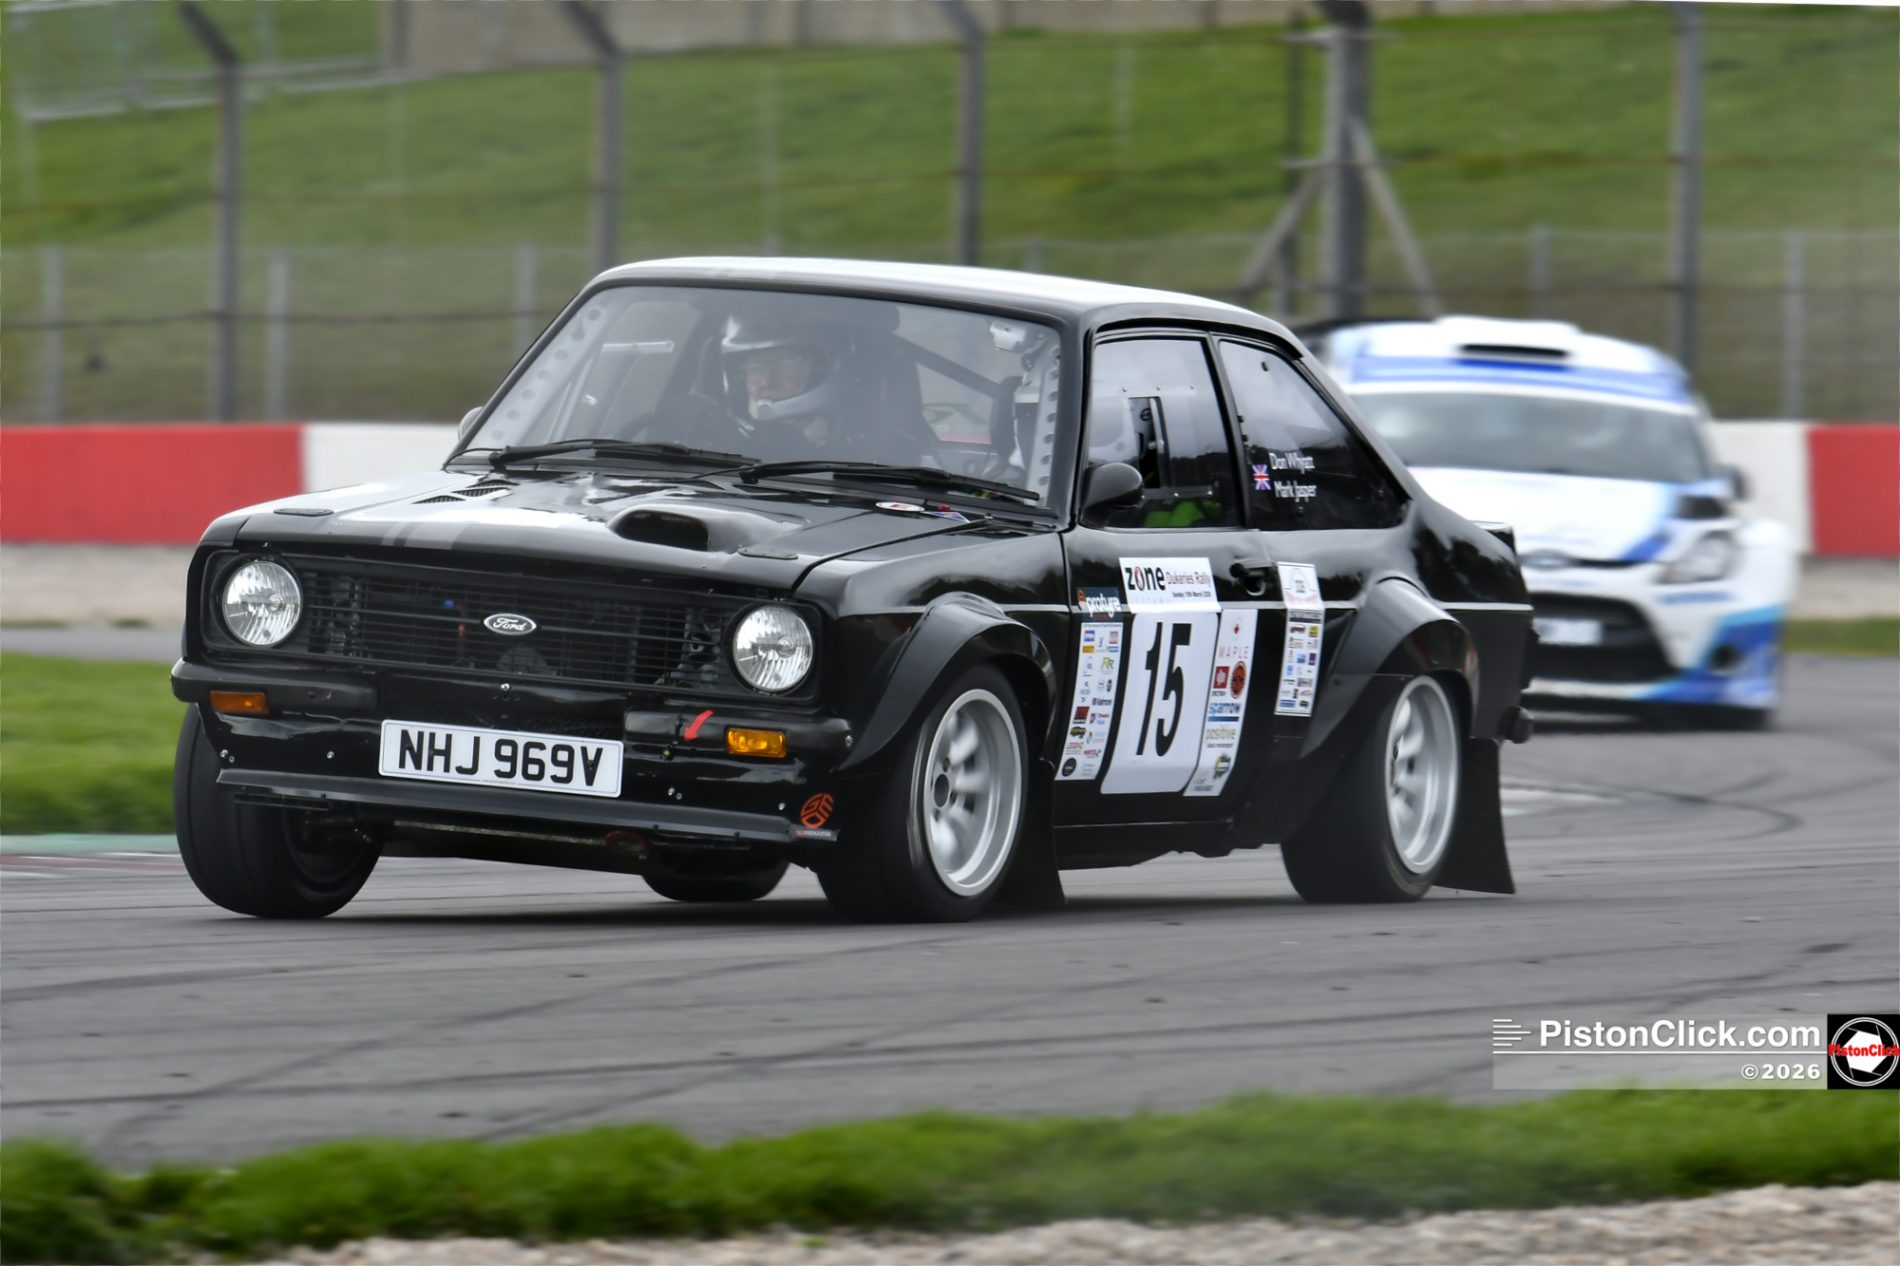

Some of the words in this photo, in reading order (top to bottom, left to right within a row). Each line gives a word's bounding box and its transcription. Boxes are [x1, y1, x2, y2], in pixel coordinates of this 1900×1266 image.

[1273, 480, 1295, 498] Mark
[1125, 566, 1166, 591] zone
[1195, 570, 1211, 588] Rally
[493, 617, 528, 631] Ford
[1136, 621, 1192, 757] 15
[399, 728, 480, 776] NHJ
[493, 738, 603, 788] 969V
